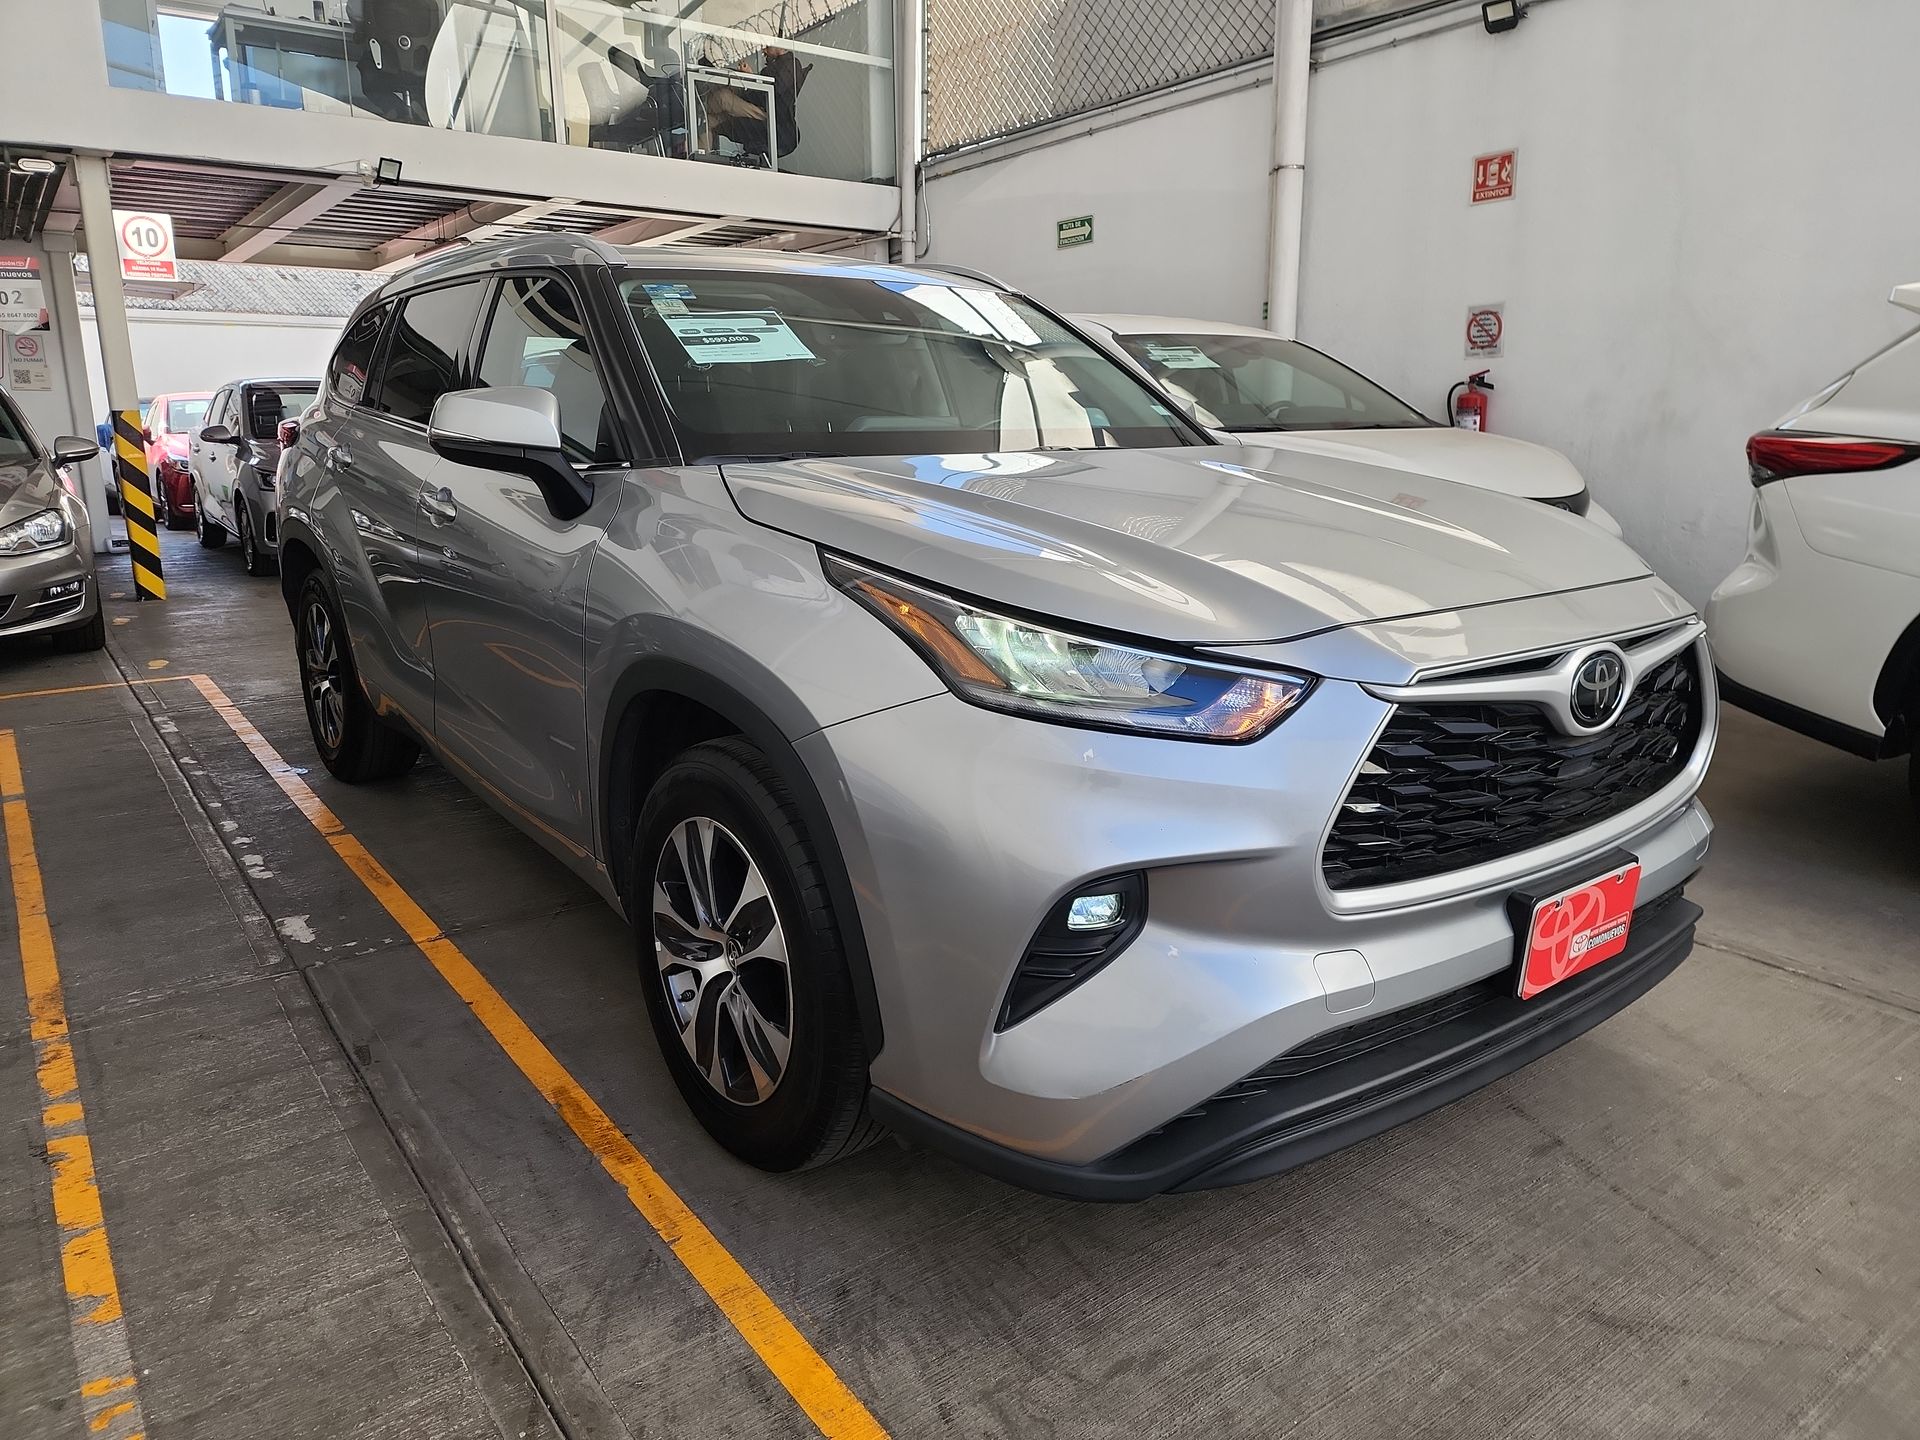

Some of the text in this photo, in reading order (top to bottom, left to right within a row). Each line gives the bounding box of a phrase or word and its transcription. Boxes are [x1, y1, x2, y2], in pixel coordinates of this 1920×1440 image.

[1475, 188, 1510, 200] EXTINTOR
[1074, 220, 1082, 228] DE
[131, 226, 159, 247] 10
[702, 336, 750, 344] $599,000
[1587, 924, 1626, 949] COMONUEVOS
